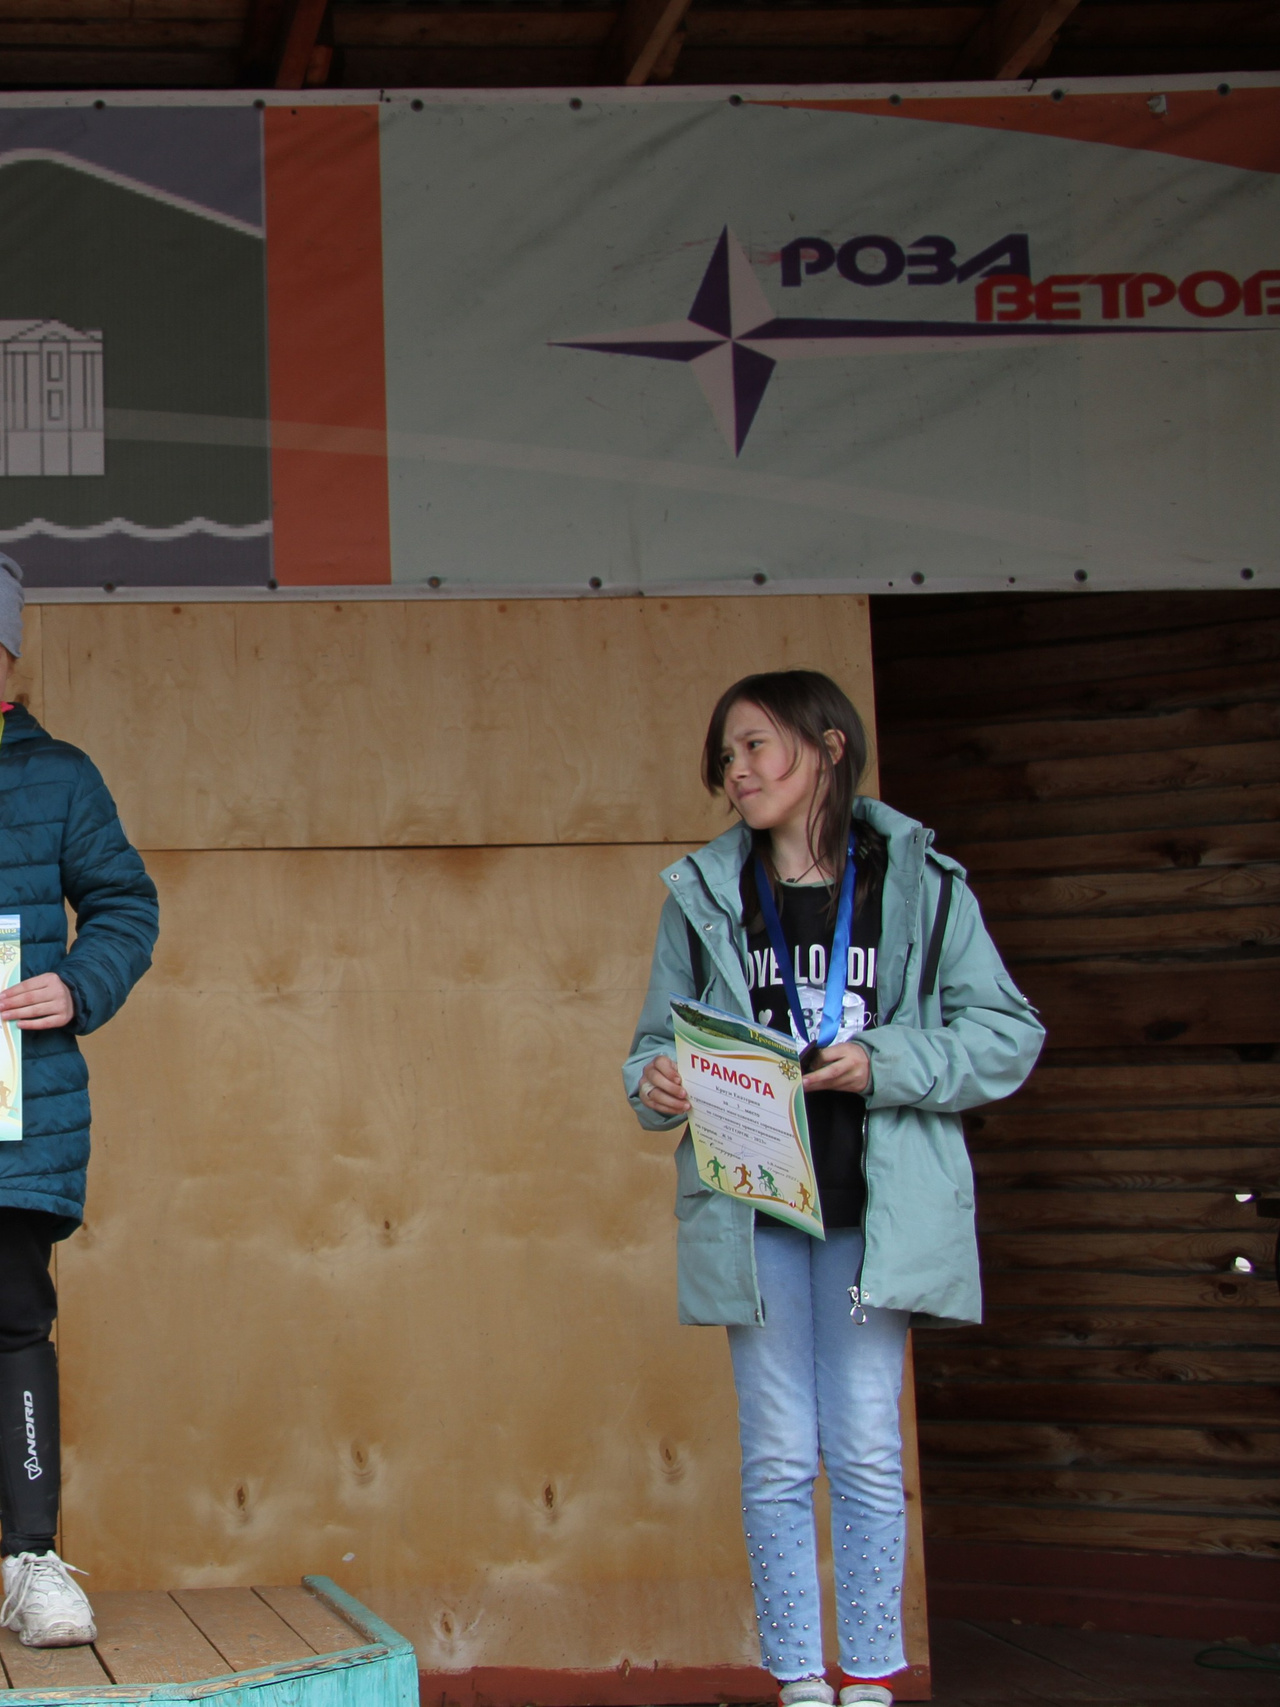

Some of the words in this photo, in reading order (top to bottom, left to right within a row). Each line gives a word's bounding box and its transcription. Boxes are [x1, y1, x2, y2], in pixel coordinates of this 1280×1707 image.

[781, 233, 1031, 287] РОЗА
[691, 1053, 776, 1100] ГРАМОТА
[24, 1390, 37, 1457] NORD
